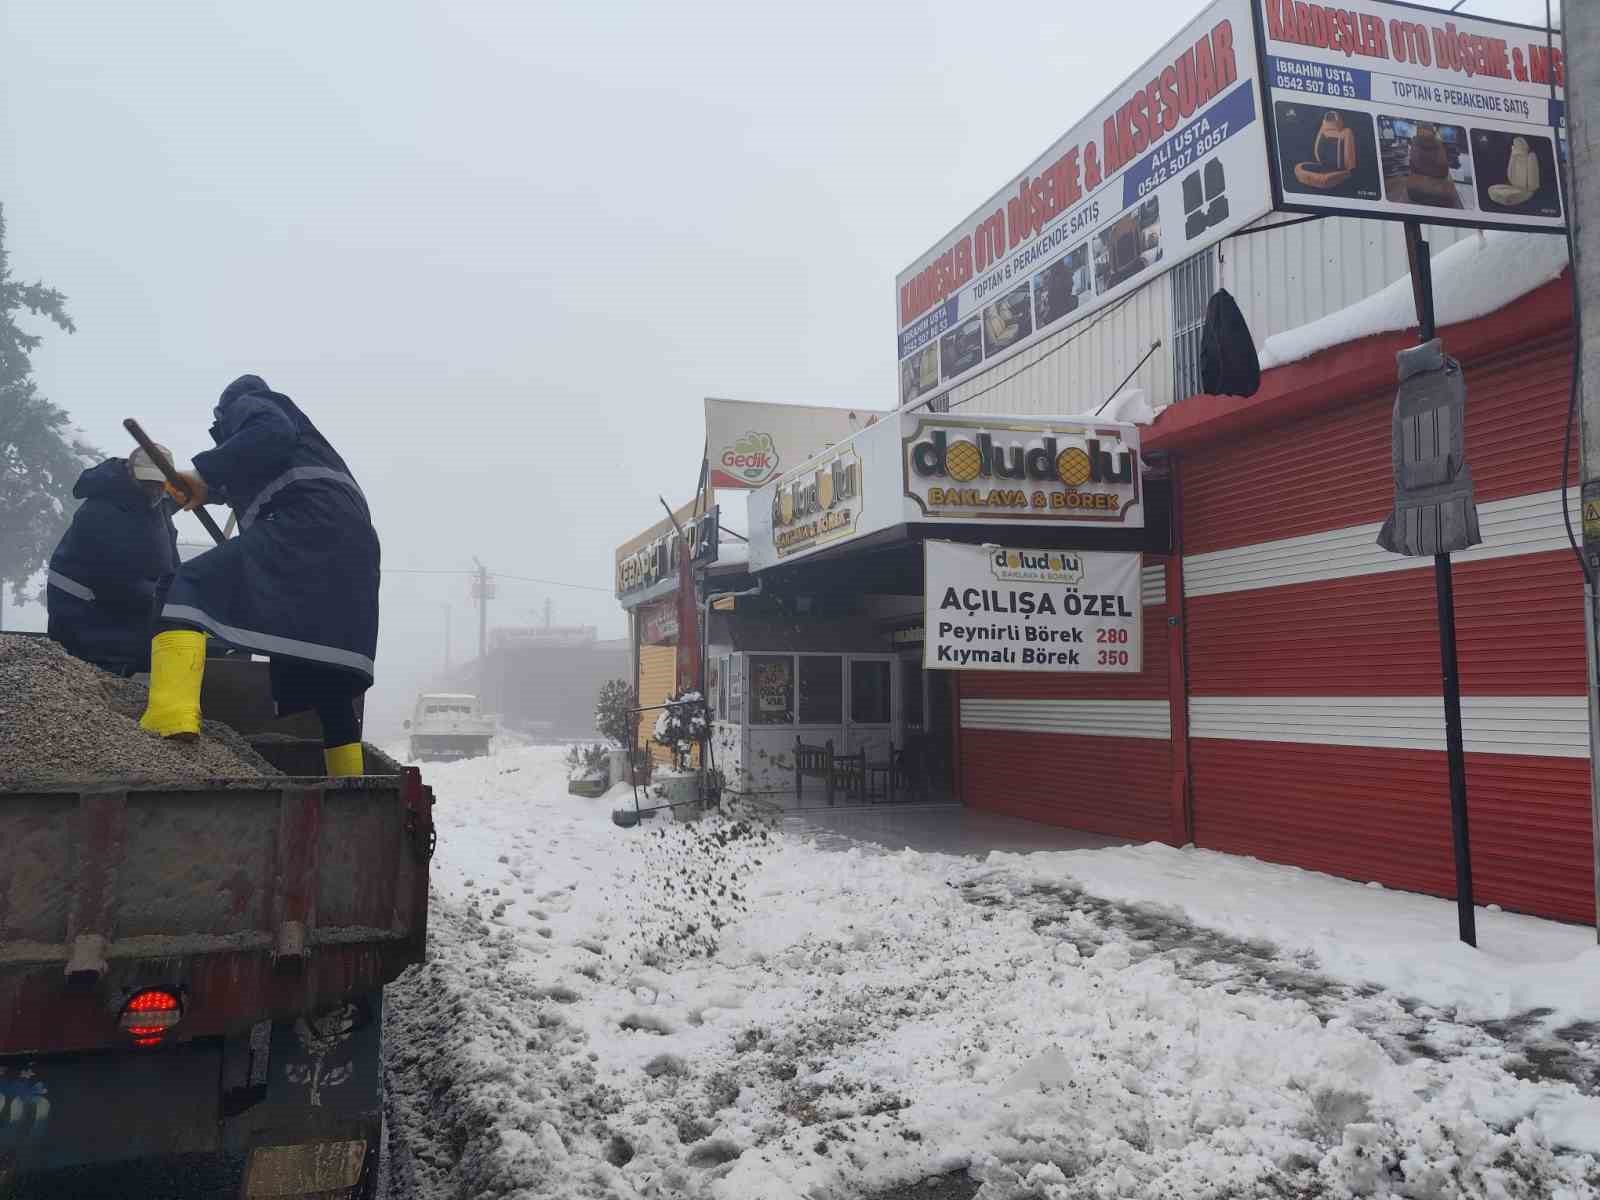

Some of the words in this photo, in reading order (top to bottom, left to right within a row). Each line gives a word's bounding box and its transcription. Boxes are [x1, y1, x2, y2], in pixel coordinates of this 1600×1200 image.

[1267, 1, 1389, 58] KARDEŞLER
[1391, 18, 1432, 68] OTO
[1431, 22, 1512, 78] DÖŞEME
[1512, 47, 1529, 83] &
[1276, 58, 1322, 78] İBRAHİM
[1325, 66, 1353, 83] USTA
[1277, 76, 1303, 91] 0542
[1306, 81, 1325, 94] 507
[1327, 84, 1341, 96] 80
[1342, 85, 1356, 98] 53
[1392, 81, 1432, 101] TOPTAN
[1434, 90, 1442, 102] &
[1443, 91, 1501, 112] PERAKENDE
[1503, 98, 1529, 119] SATIŞ
[975, 207, 1006, 274] OTO
[1084, 140, 1103, 193] &
[1103, 19, 1237, 180] AKSESUAR
[1174, 117, 1211, 152] USTA
[1138, 167, 1167, 198] 0542
[1169, 148, 1192, 175] 507
[1196, 121, 1230, 156] 8057
[972, 266, 1004, 300] TOPTAN
[1004, 265, 1013, 280] &
[1012, 226, 1070, 276] PERAKENDE
[1069, 201, 1100, 234] SATIŞ
[722, 449, 770, 469] Gedik
[911, 430, 1131, 487] doludolu
[928, 487, 1027, 508] BAKLAVA
[1031, 490, 1047, 508] &
[1051, 488, 1119, 511] BÖREK
[995, 550, 1079, 571] doludolu
[940, 586, 1056, 620] AÇILIŞA
[1064, 588, 1132, 617] ÖZEL
[939, 622, 1021, 643] Peynirli
[1025, 625, 1083, 643] Börek
[1096, 629, 1128, 644] 280
[937, 645, 1016, 666] Kıymalı
[1022, 648, 1080, 666] Börek
[1097, 651, 1129, 666] 350
